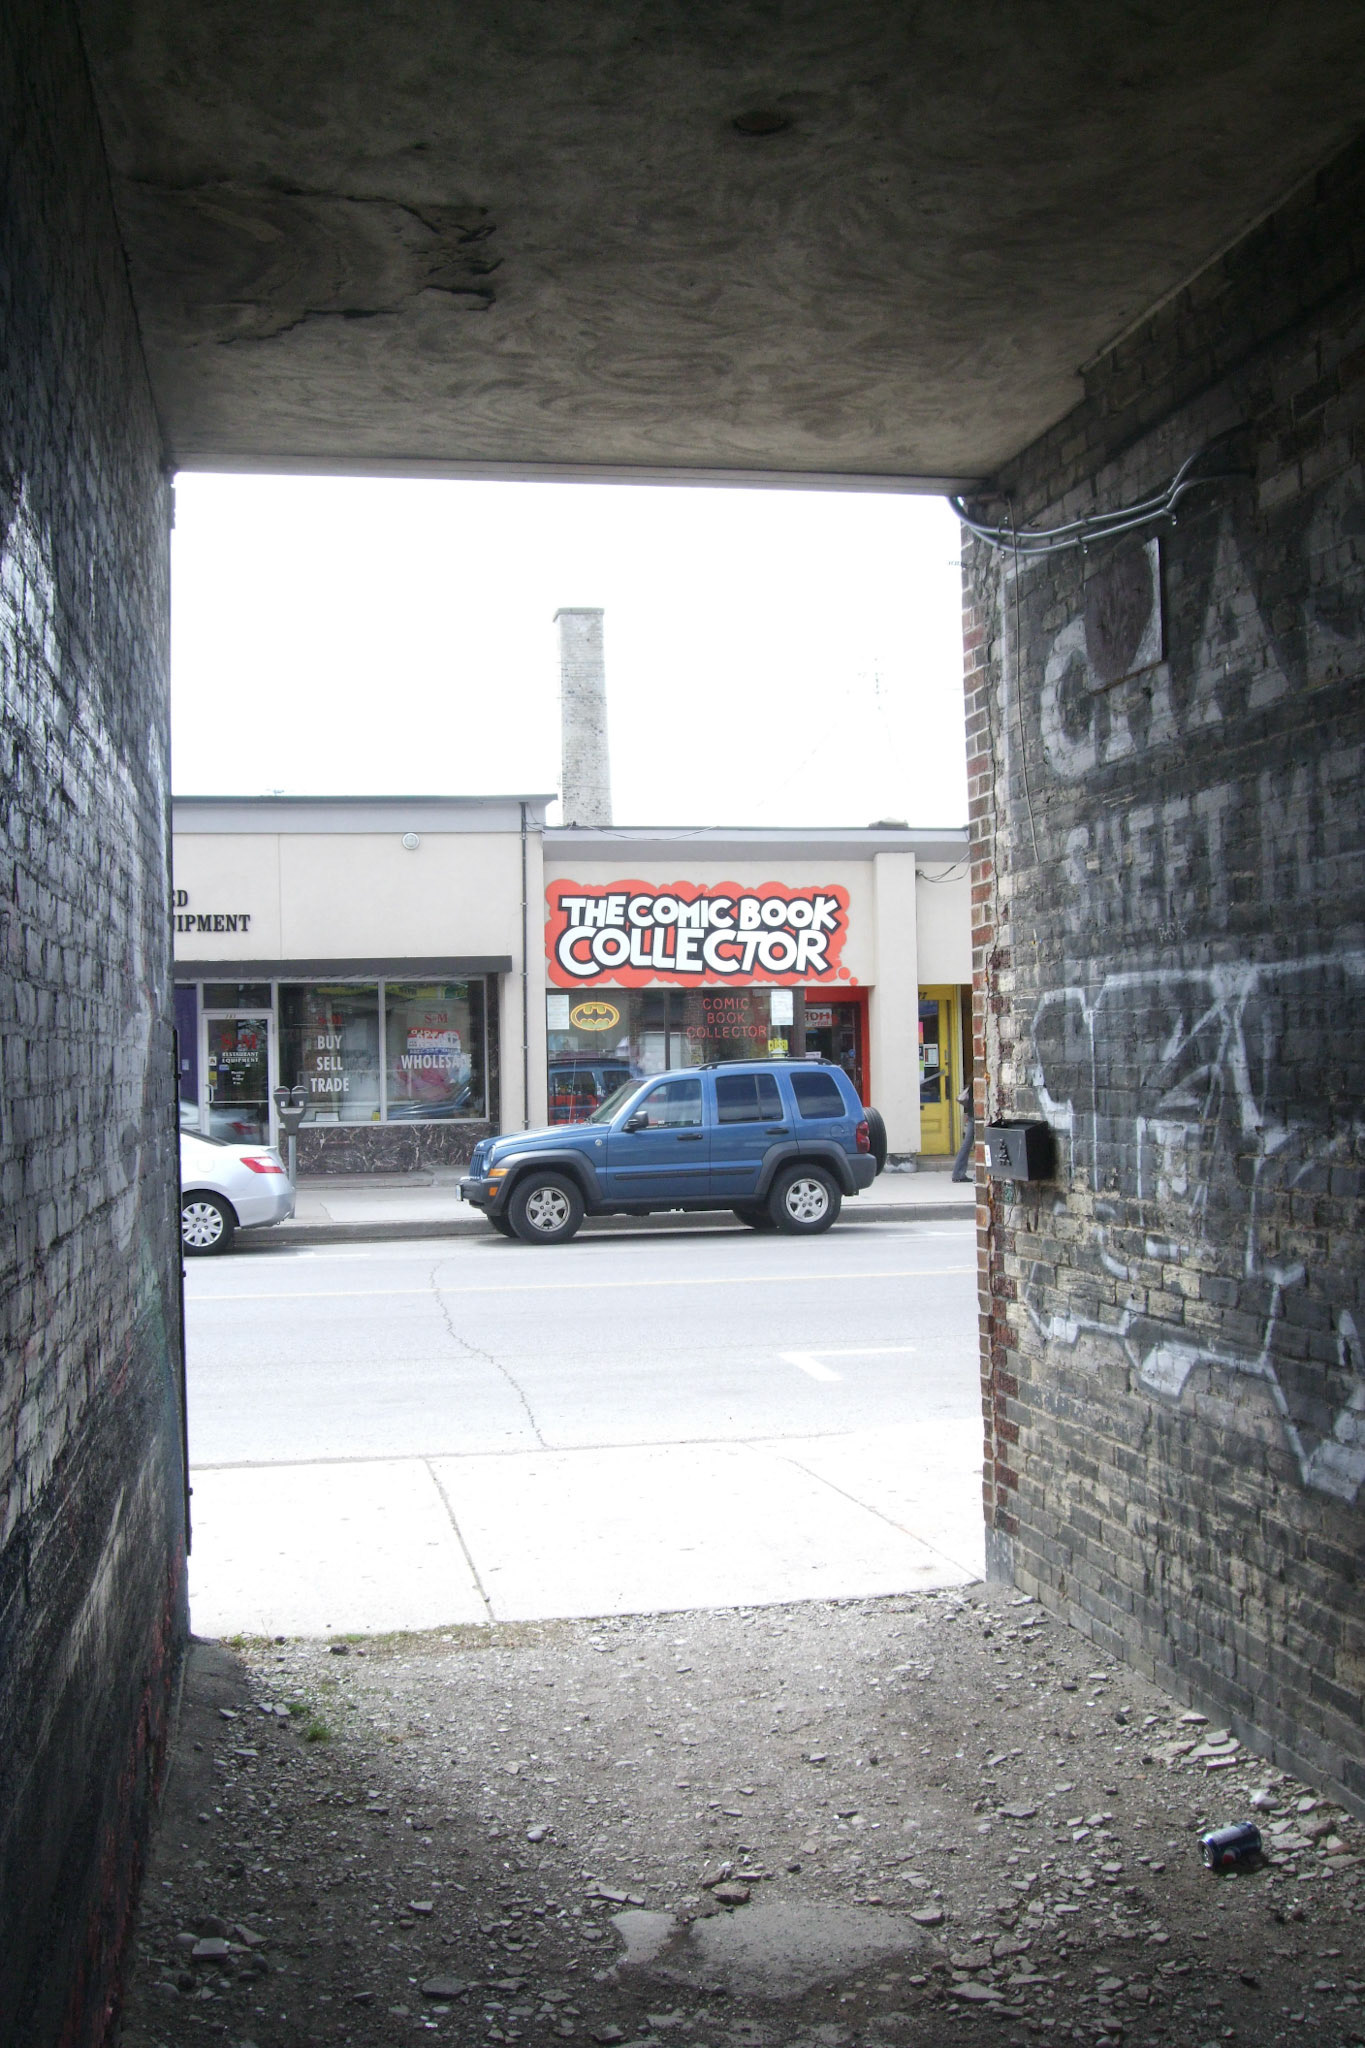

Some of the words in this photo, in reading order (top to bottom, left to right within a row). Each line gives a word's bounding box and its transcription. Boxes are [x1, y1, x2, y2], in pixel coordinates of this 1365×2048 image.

[173, 889, 188, 907] D
[561, 894, 628, 928] THE
[626, 895, 736, 929] COMIC
[738, 896, 839, 931] BOOK
[173, 914, 251, 932] IPMENT
[558, 925, 829, 976] COLLECTOR
[702, 998, 749, 1010] COMIC
[707, 1012, 745, 1024] BOOK
[686, 1025, 767, 1039] COLLECTOR
[317, 1035, 342, 1050] BUY
[316, 1056, 343, 1071] SELL
[310, 1077, 349, 1092] TRADE
